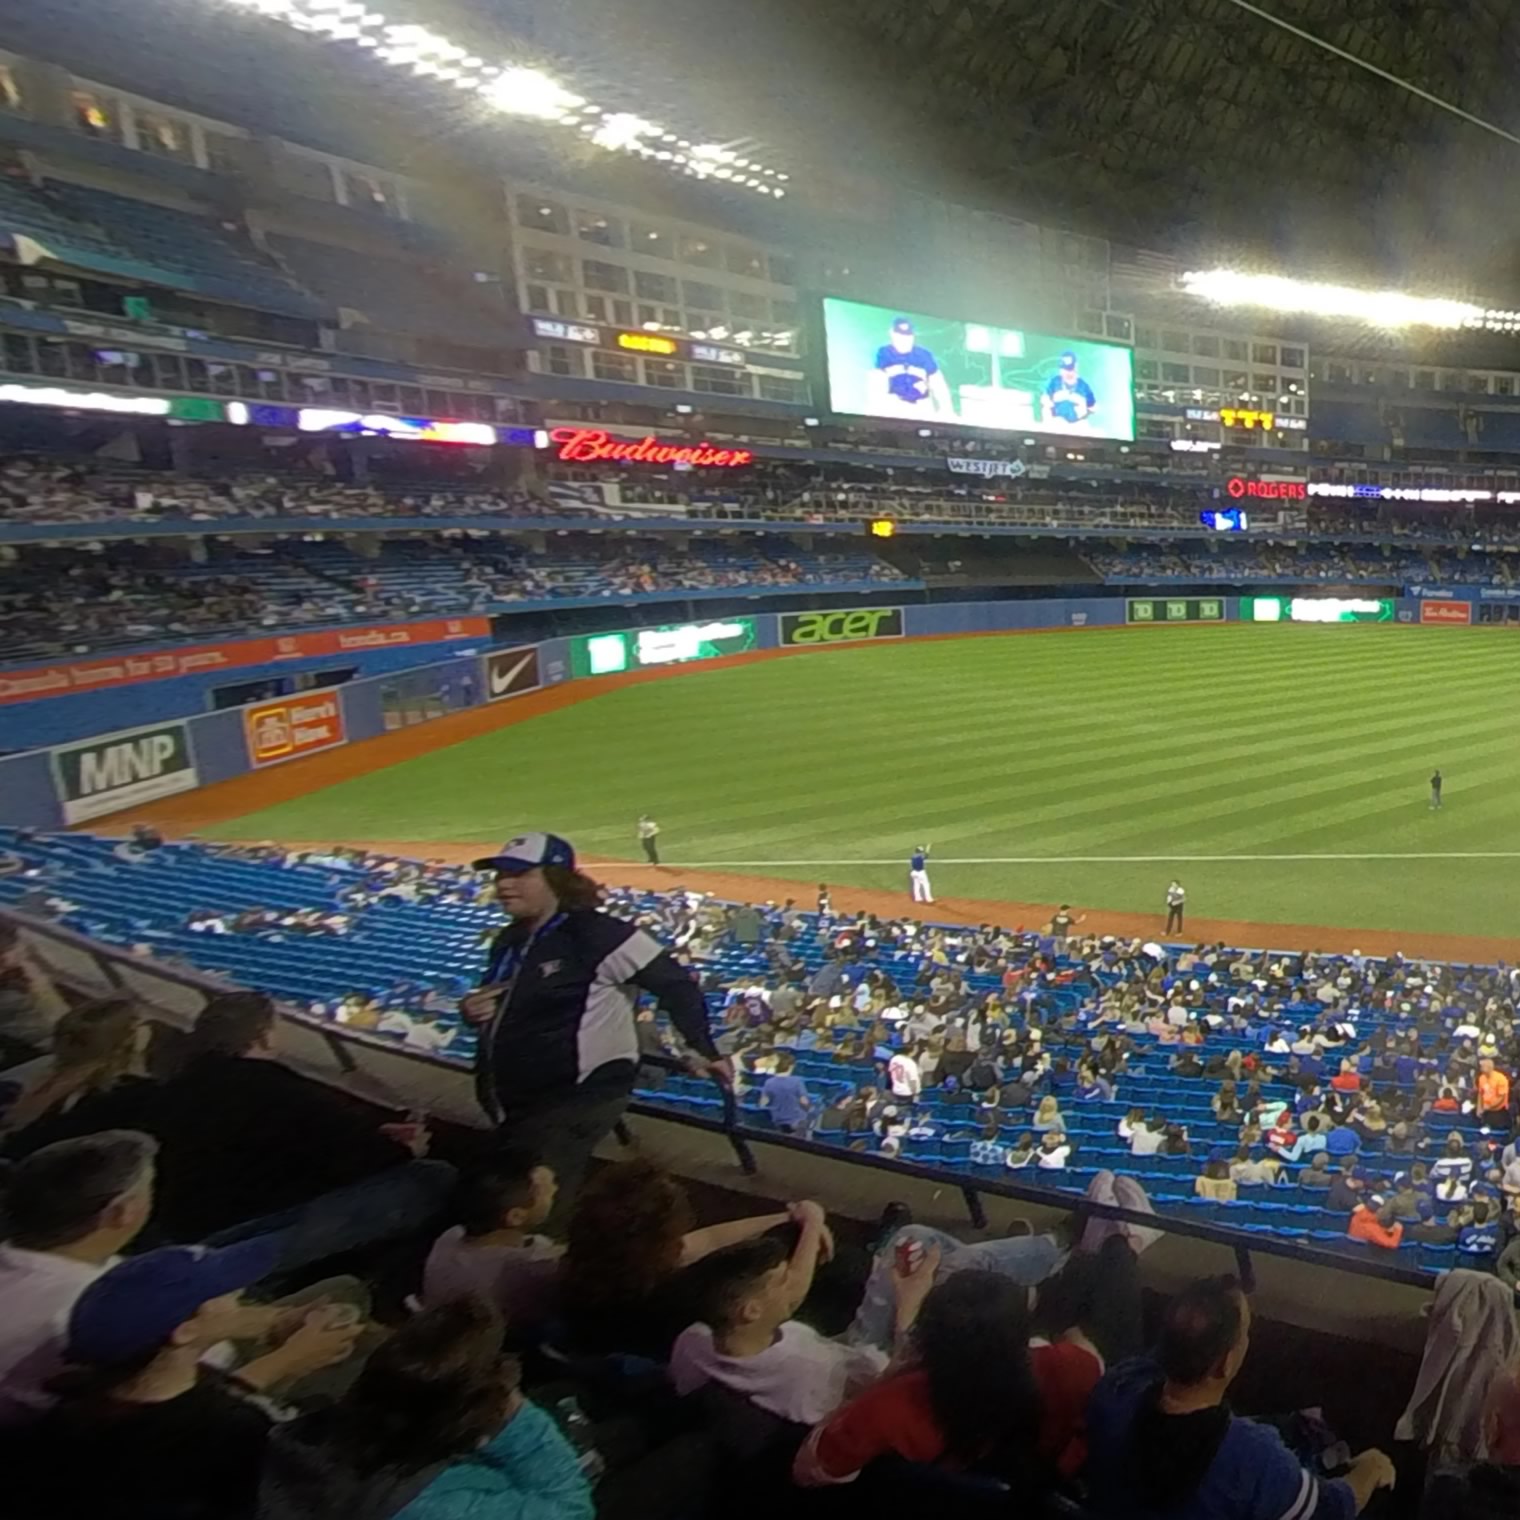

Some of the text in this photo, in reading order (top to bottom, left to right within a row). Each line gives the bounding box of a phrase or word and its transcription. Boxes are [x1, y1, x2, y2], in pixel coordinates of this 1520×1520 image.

[551, 428, 752, 467] Budweiser
[1247, 481, 1305, 500] ROGERS
[792, 610, 893, 643] acer
[79, 734, 175, 795] MNP
